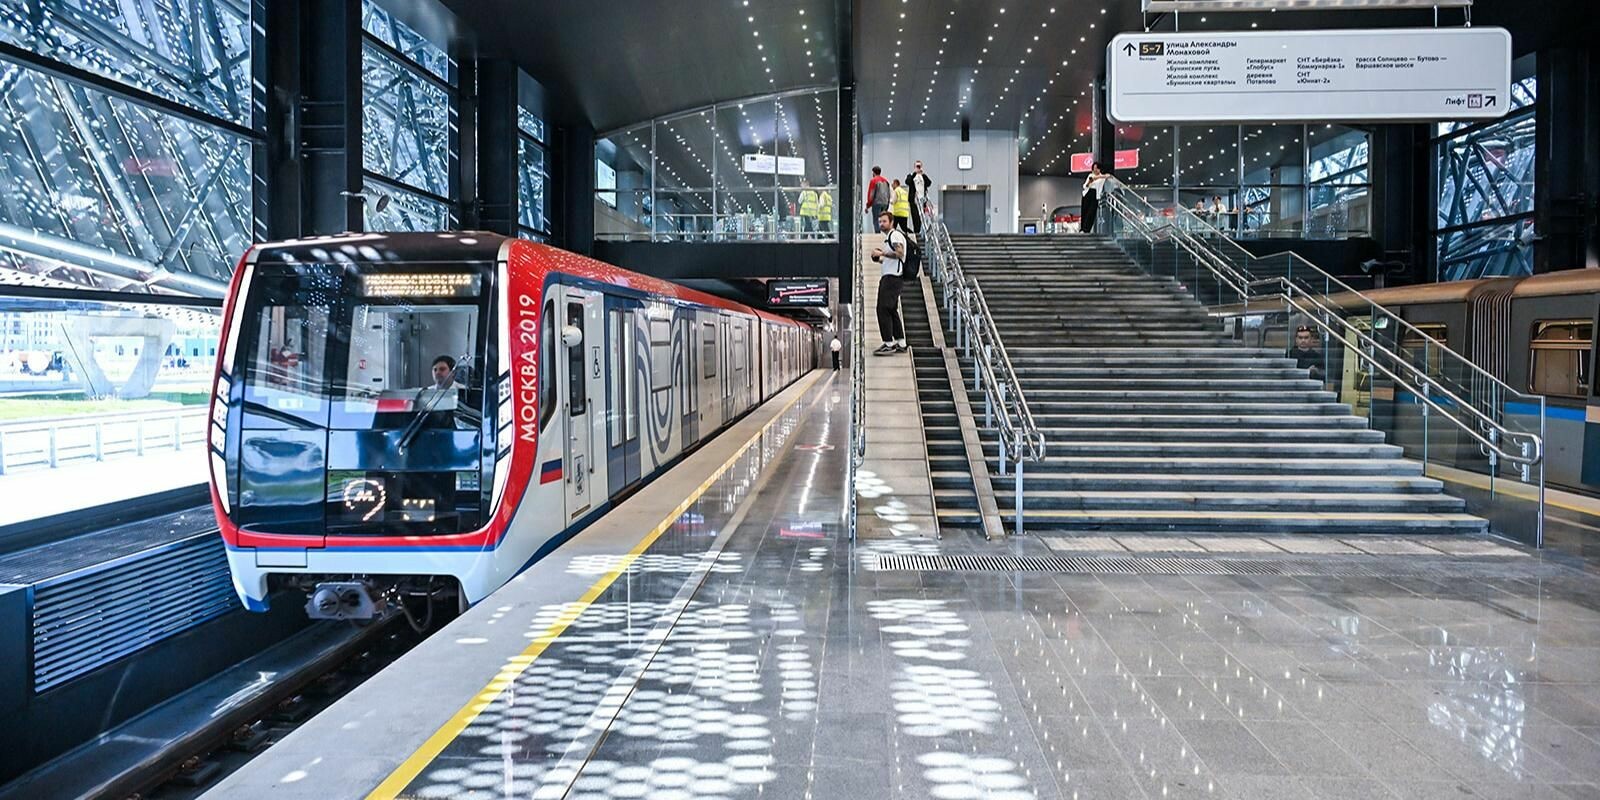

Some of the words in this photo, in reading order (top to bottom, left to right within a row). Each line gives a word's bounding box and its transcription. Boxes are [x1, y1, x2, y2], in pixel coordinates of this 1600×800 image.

[1445, 98, 1465, 106] Лифт
[519, 294, 537, 344] 2019
[520, 350, 538, 442] МОСКВА
